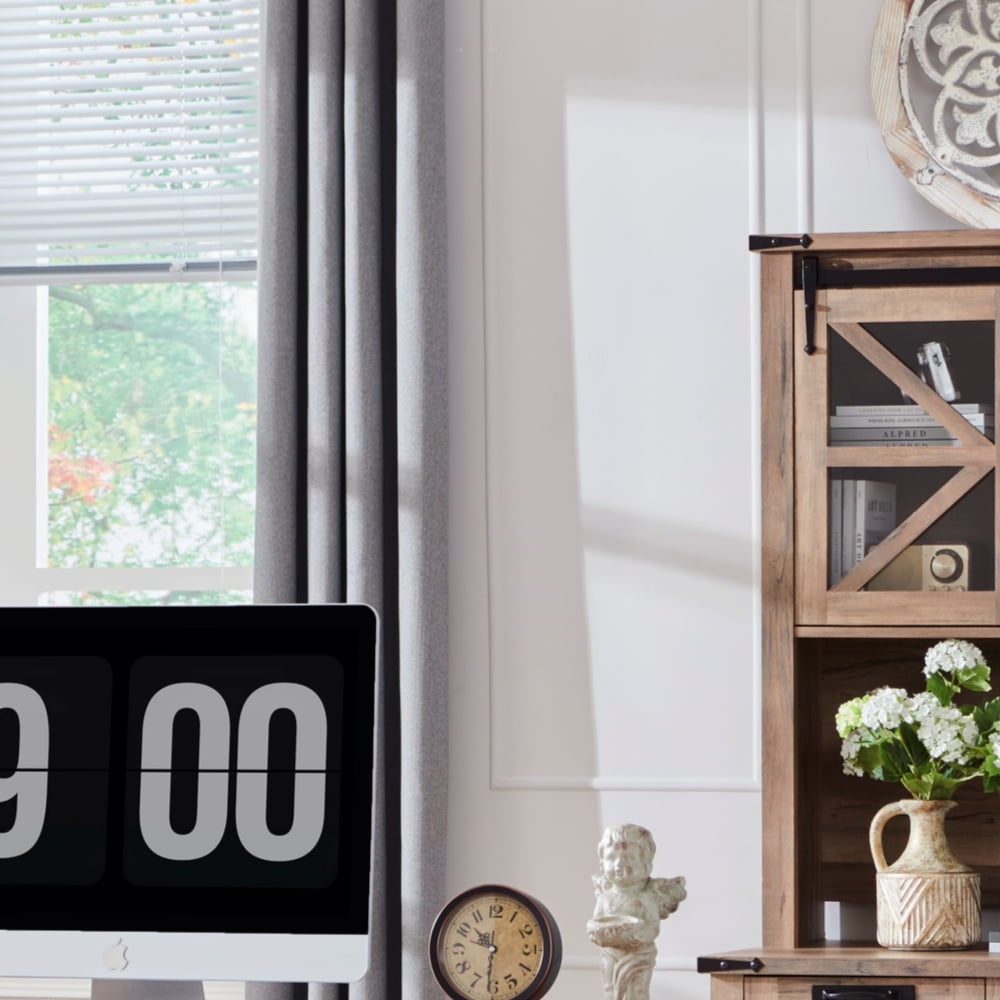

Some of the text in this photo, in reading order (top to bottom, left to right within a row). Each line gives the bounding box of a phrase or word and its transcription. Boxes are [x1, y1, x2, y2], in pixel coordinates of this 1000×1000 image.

[139, 682, 328, 862] 00
[472, 910, 483, 923] 11
[489, 905, 503, 918] 12
[510, 911, 518, 923] 1
[457, 922, 471, 938] 10
[519, 924, 533, 939] 2
[452, 943, 465, 955] 9
[522, 944, 537, 956] 3
[456, 960, 471, 974] 8
[470, 972, 482, 988] 7
[504, 974, 518, 990] 5
